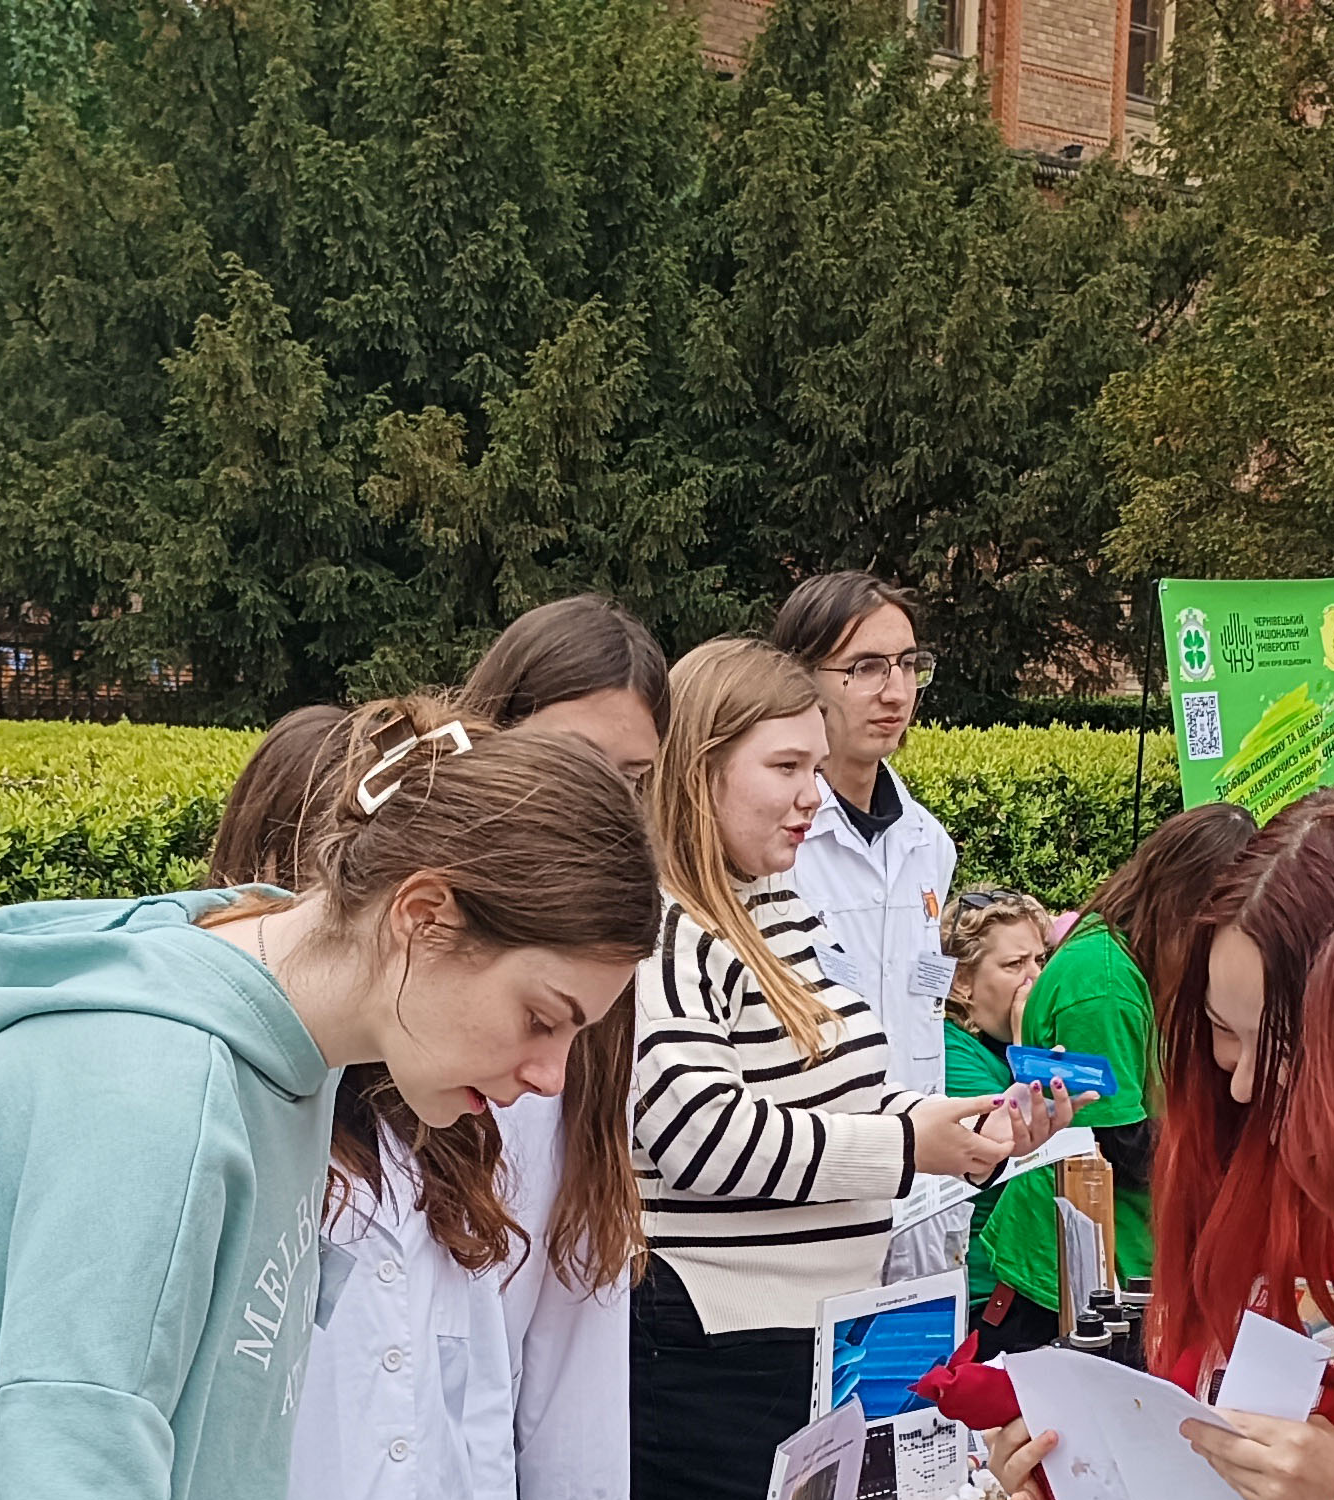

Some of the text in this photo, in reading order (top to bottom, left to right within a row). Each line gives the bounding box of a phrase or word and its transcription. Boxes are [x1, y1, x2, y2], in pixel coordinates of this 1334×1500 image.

[1254, 614, 1304, 626] ЧЕРНІВЕЦЬКИЙ
[1255, 626, 1309, 641] НАЦІОНАЛЬНИЙ
[1256, 641, 1300, 653] УНІВЕРСИТЕТ
[1222, 648, 1254, 673] ЧНУ
